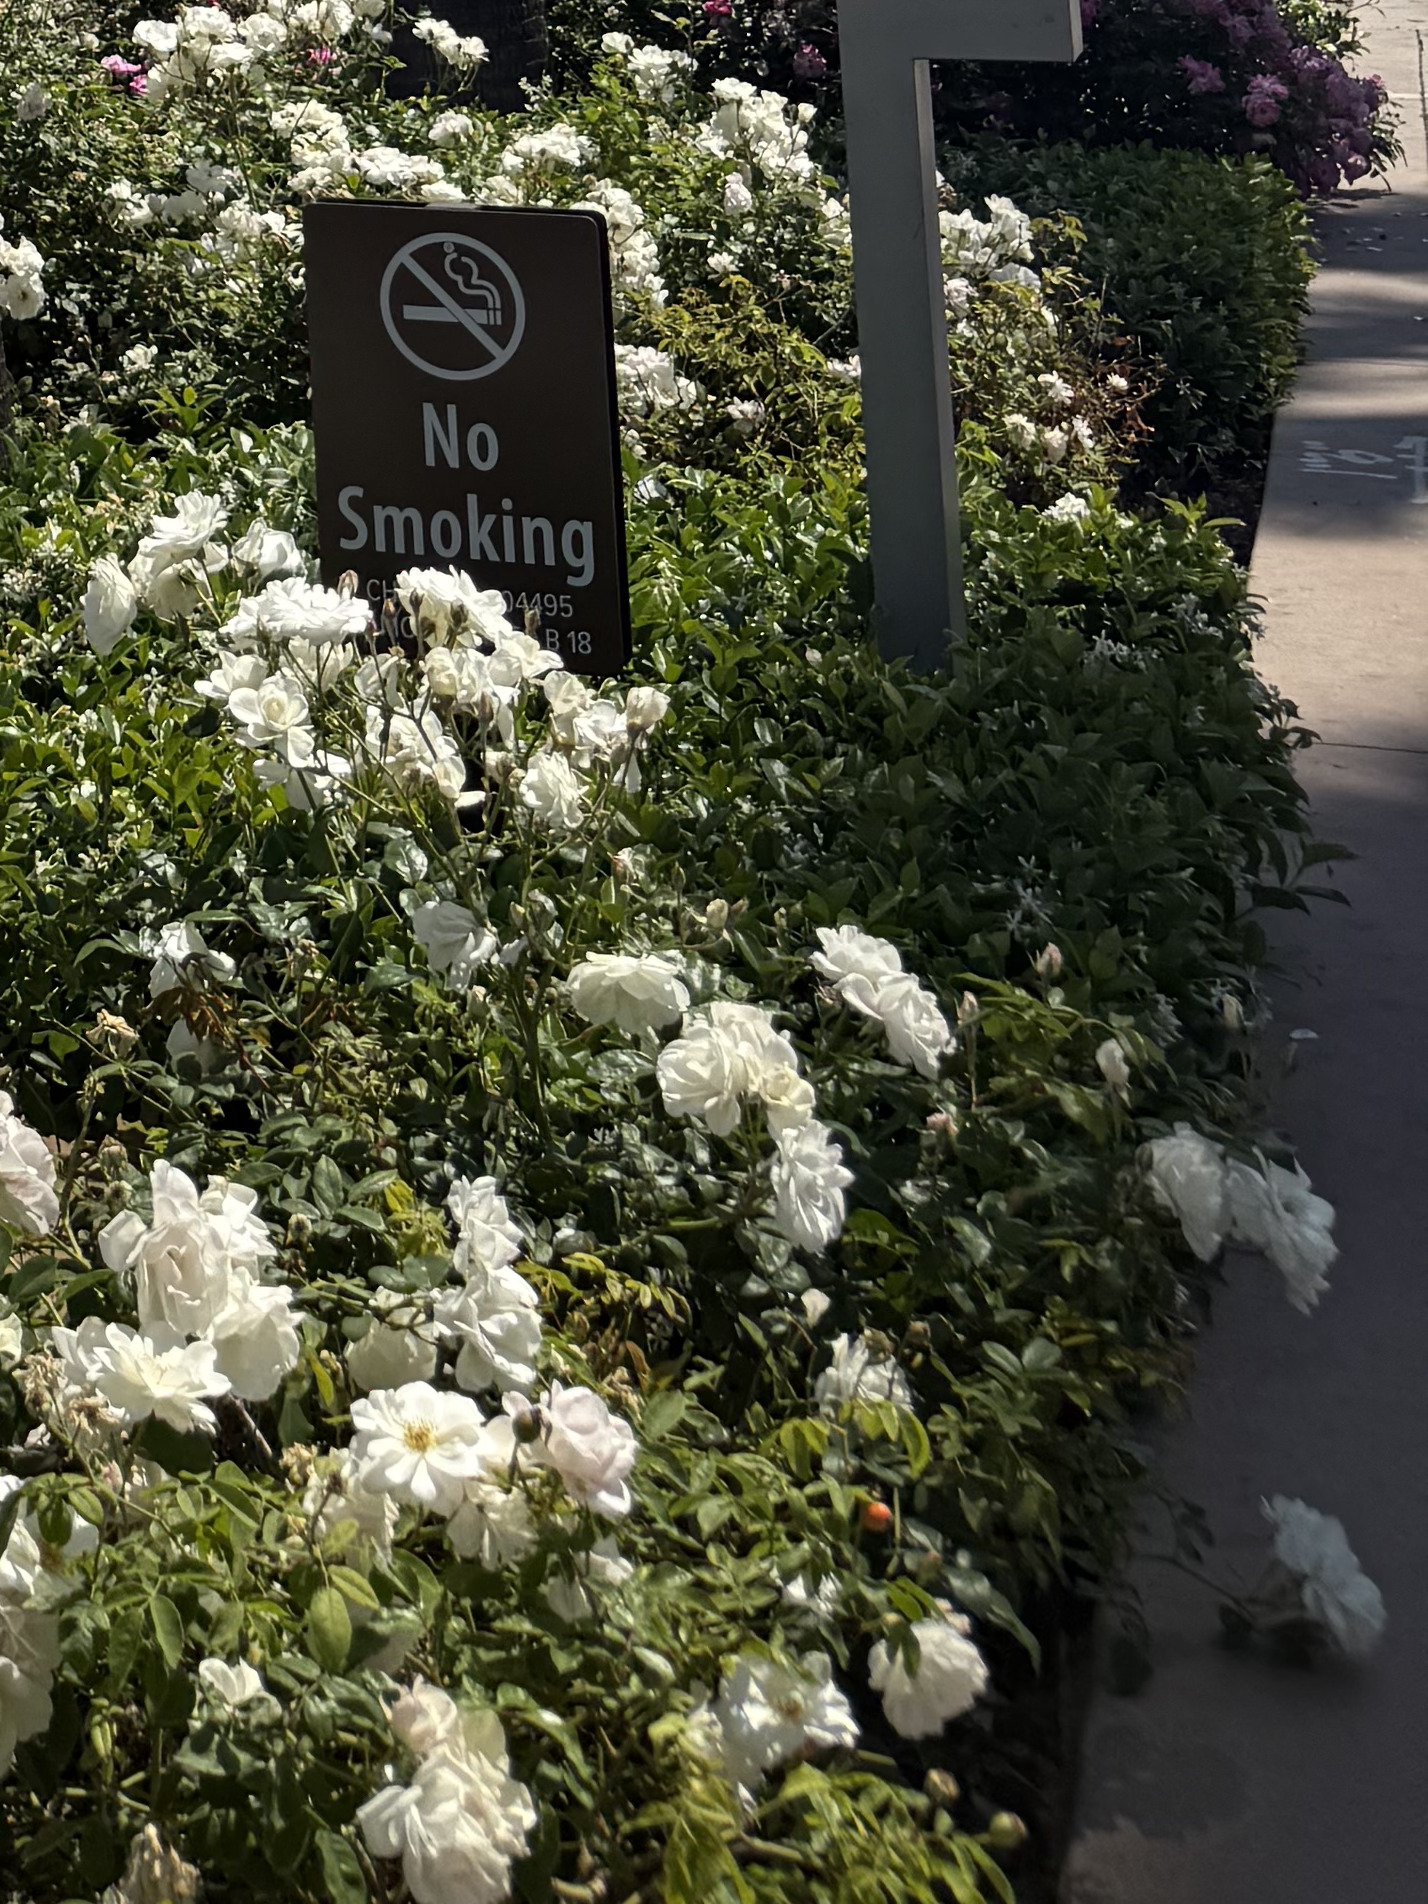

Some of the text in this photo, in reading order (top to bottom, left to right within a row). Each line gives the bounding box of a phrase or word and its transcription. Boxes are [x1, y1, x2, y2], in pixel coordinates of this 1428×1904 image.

[422, 402, 499, 472] No
[338, 485, 596, 587] Smoking
[545, 628, 592, 655] B 18
